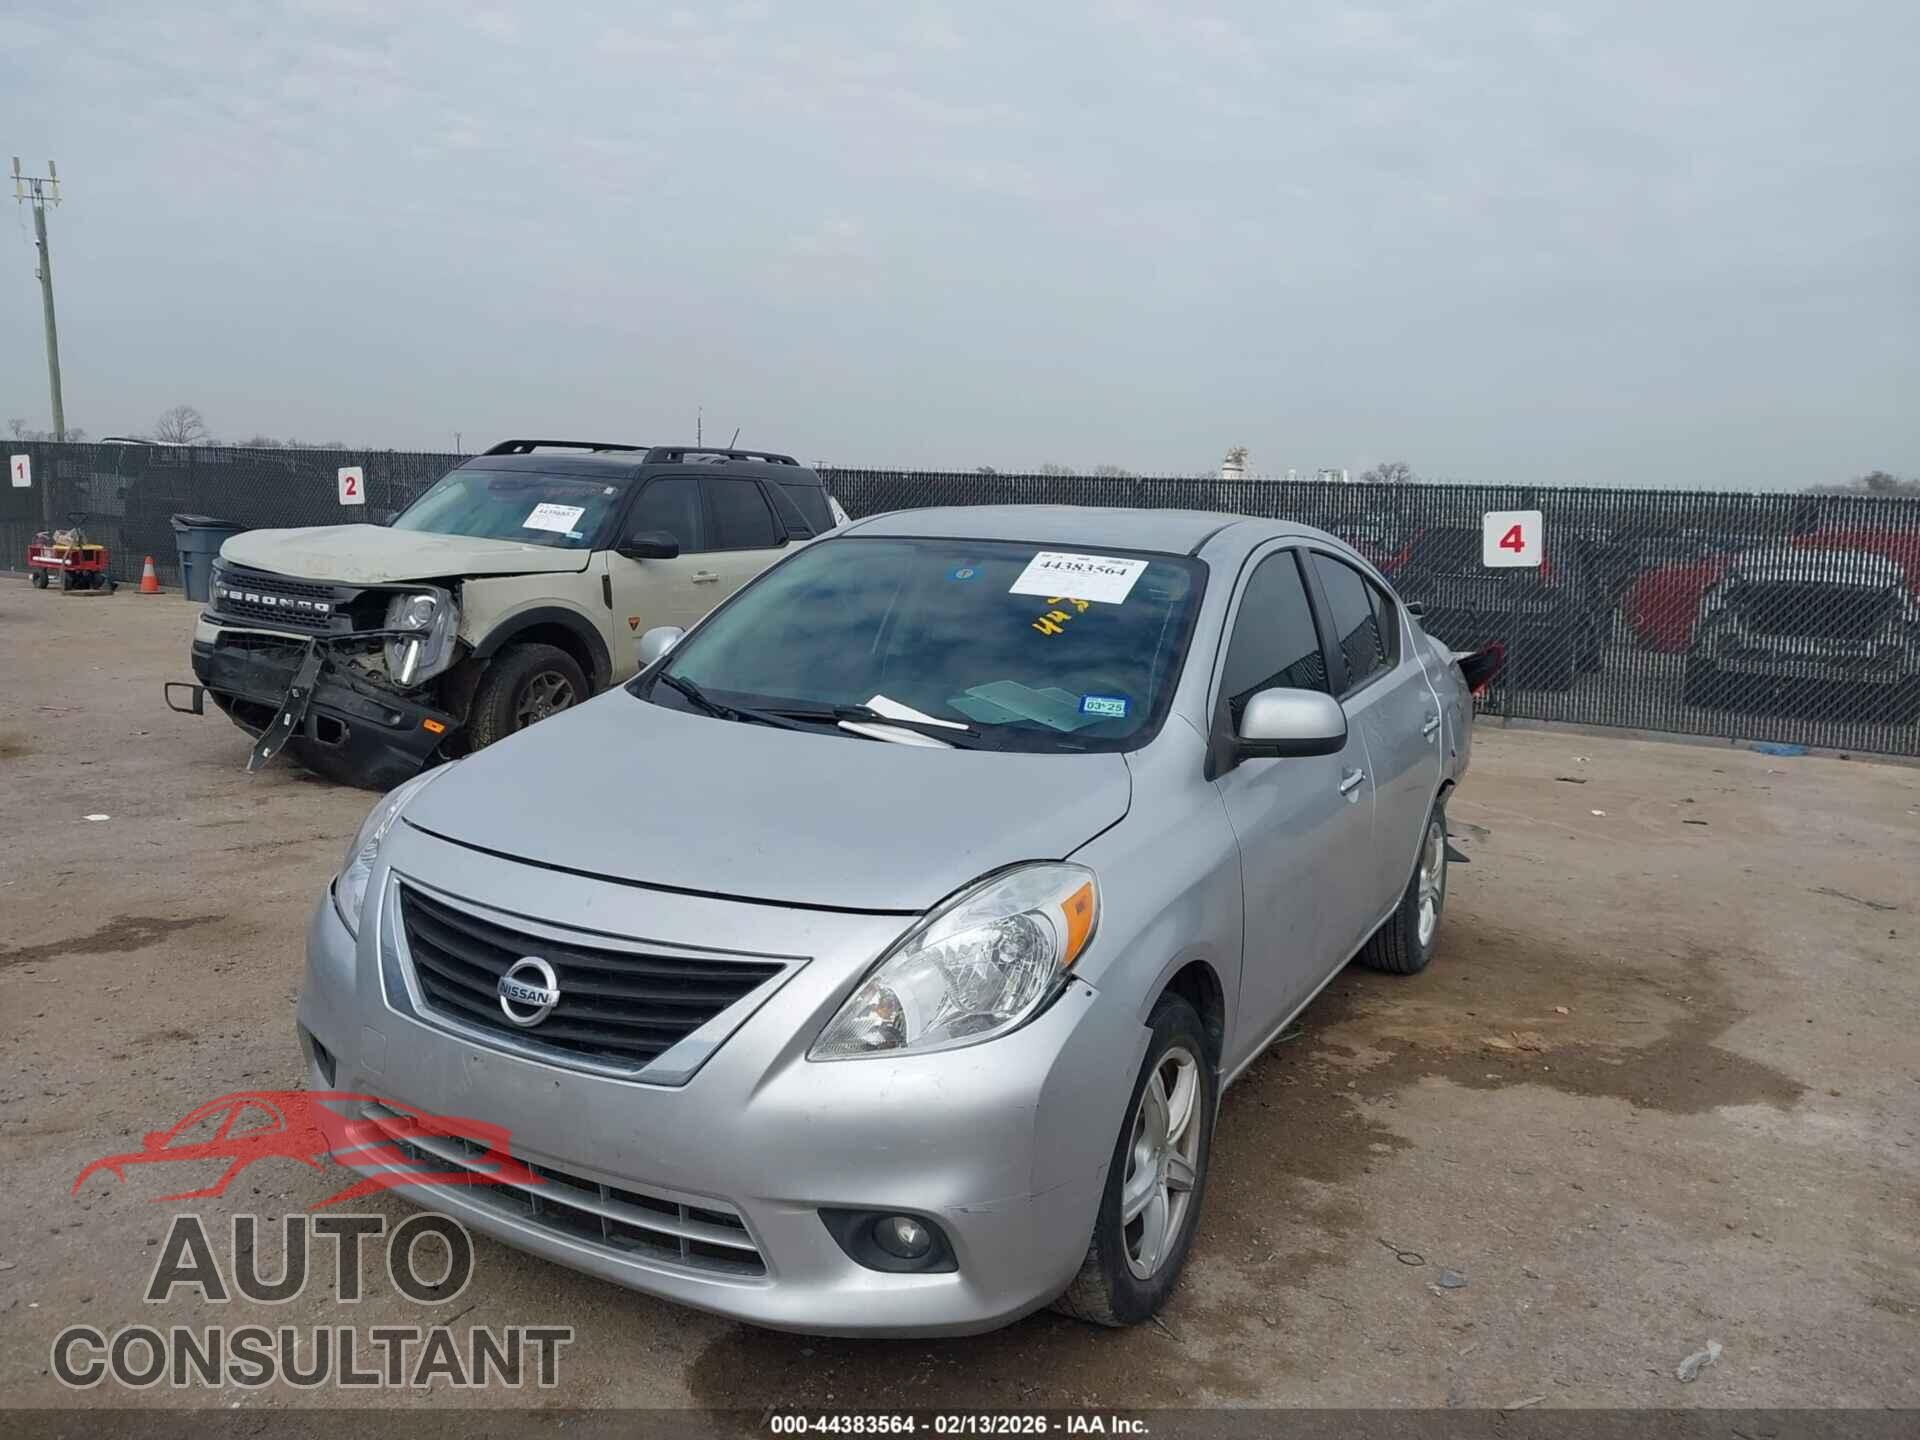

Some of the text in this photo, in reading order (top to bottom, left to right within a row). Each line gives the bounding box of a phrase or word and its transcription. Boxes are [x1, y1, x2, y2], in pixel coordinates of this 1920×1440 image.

[16, 463, 24, 479] 1
[345, 477, 357, 496] 2
[1499, 524, 1526, 553] 4
[1040, 561, 1127, 576] 44383564
[229, 590, 329, 612] BRONCO
[502, 983, 549, 1003] NISSAN
